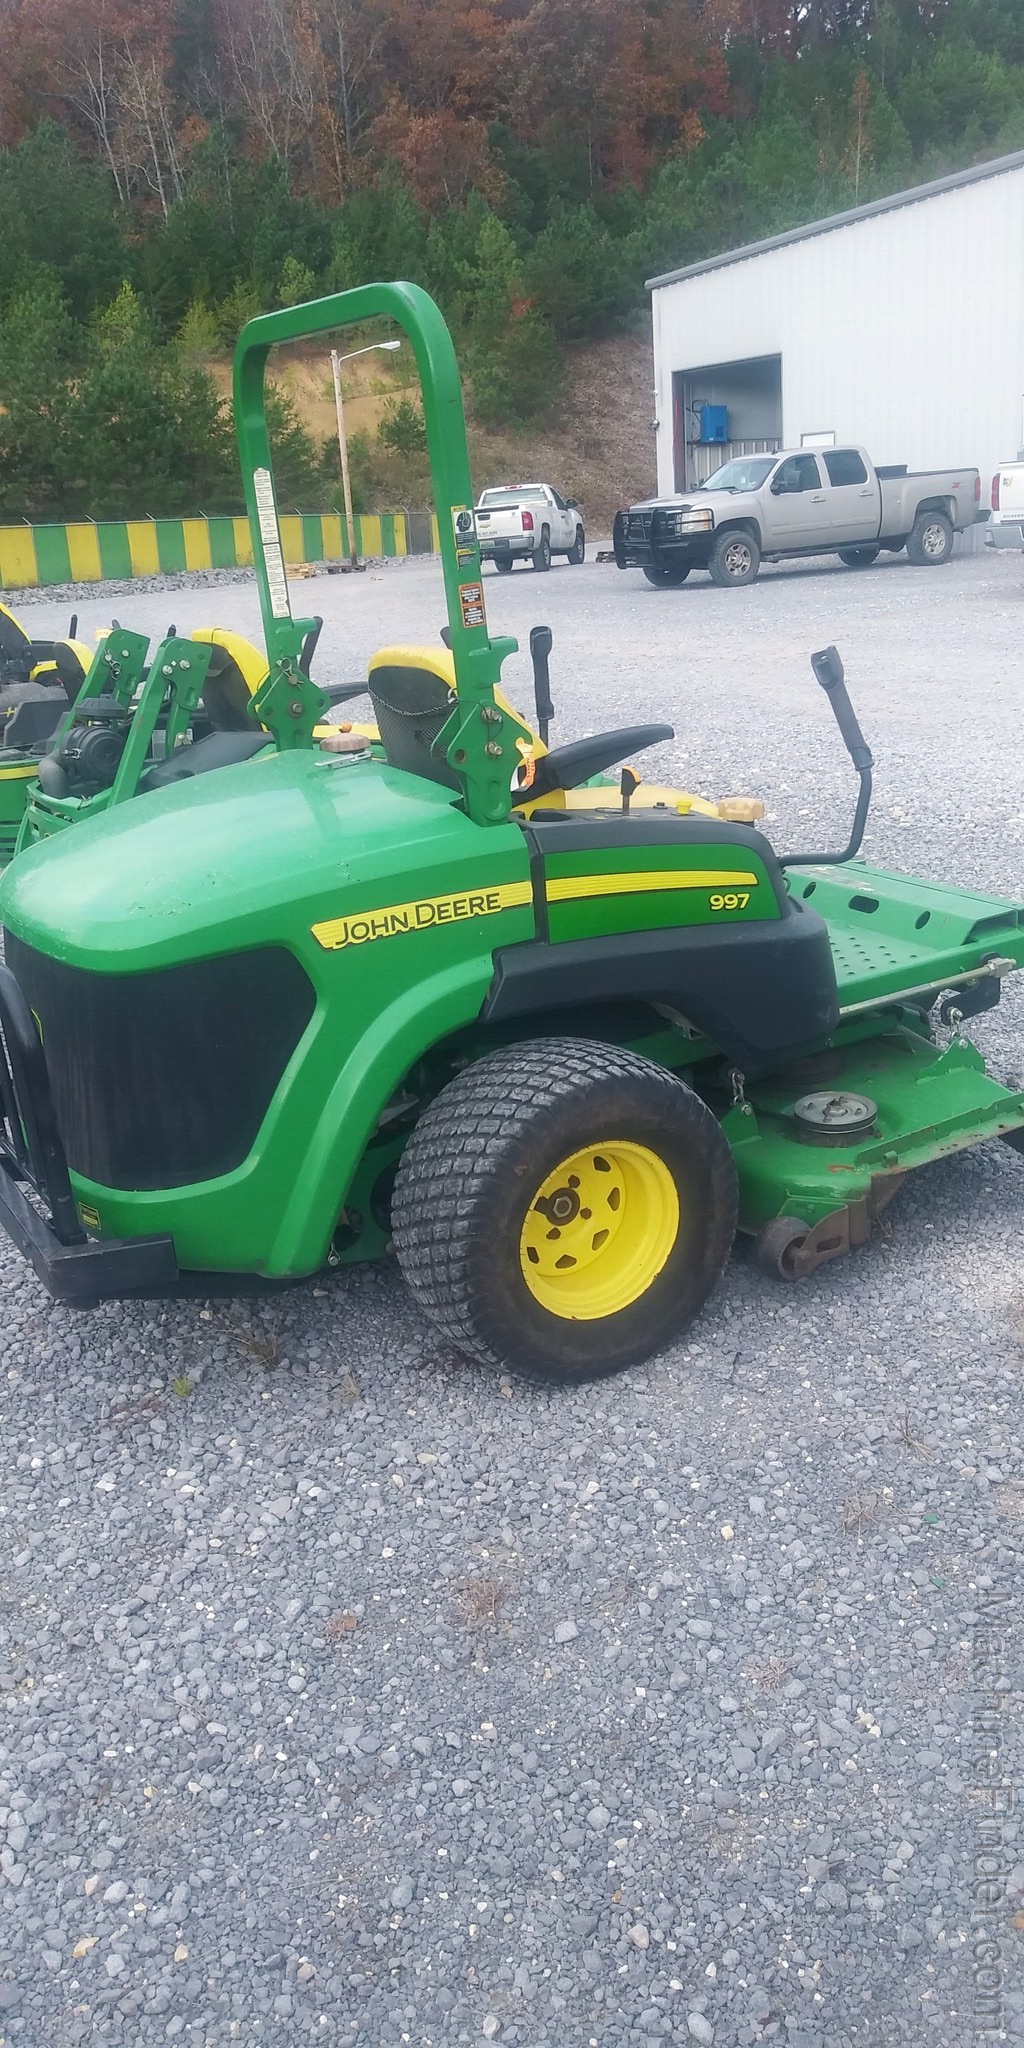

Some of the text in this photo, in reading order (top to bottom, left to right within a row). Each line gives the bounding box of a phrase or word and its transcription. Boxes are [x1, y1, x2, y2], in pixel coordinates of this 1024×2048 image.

[335, 892, 501, 946] JOHN DEERE
[709, 893, 750, 910] 997
